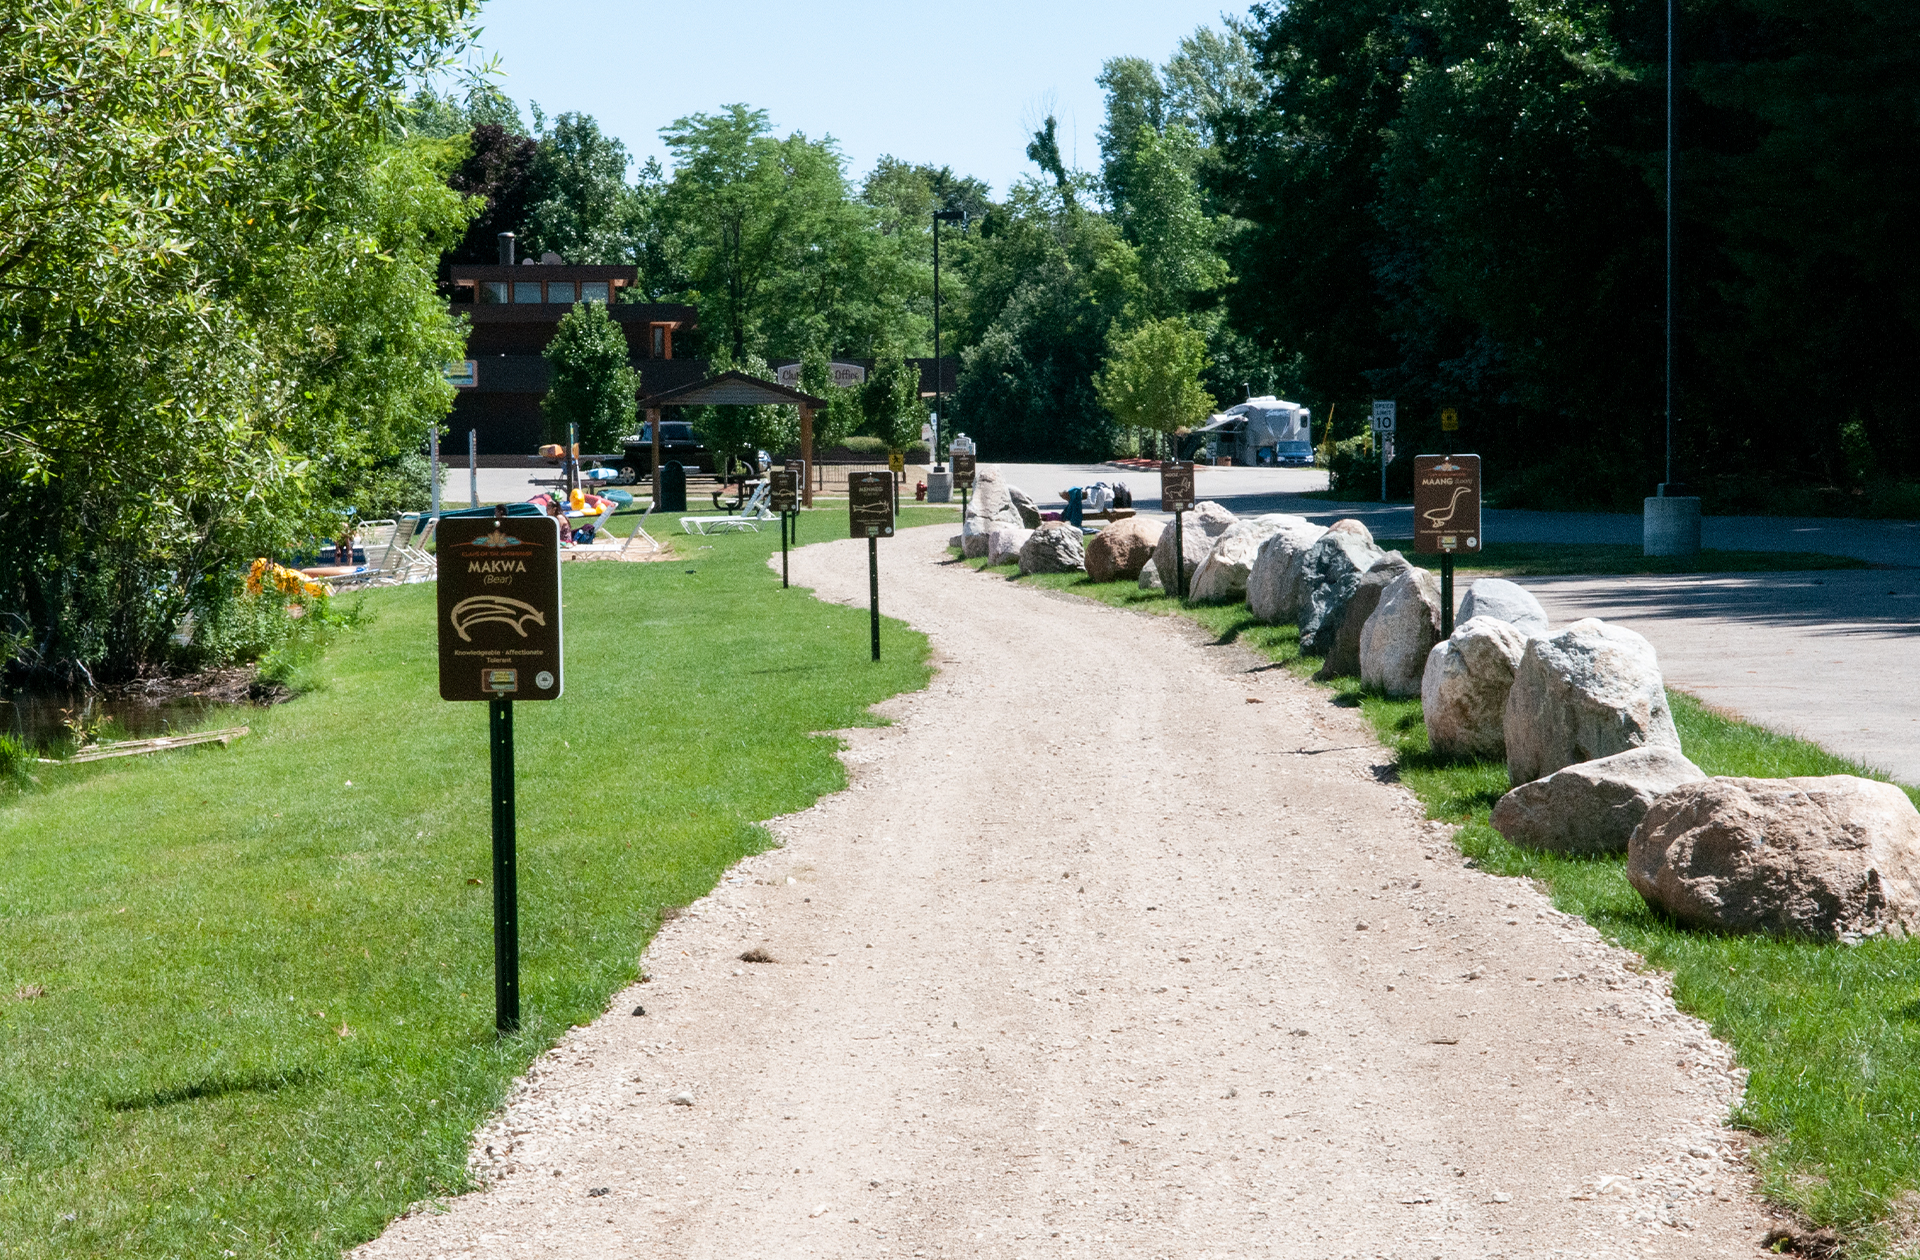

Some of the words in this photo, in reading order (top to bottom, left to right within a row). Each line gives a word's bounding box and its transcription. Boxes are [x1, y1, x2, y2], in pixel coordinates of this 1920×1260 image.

[1376, 416, 1392, 429] 10
[1421, 477, 1454, 486] MAANG
[467, 560, 527, 573] MAKWA
[483, 574, 513, 586] (Bear)
[454, 649, 501, 657] Knowledgeable
[505, 648, 544, 656] Affectionate
